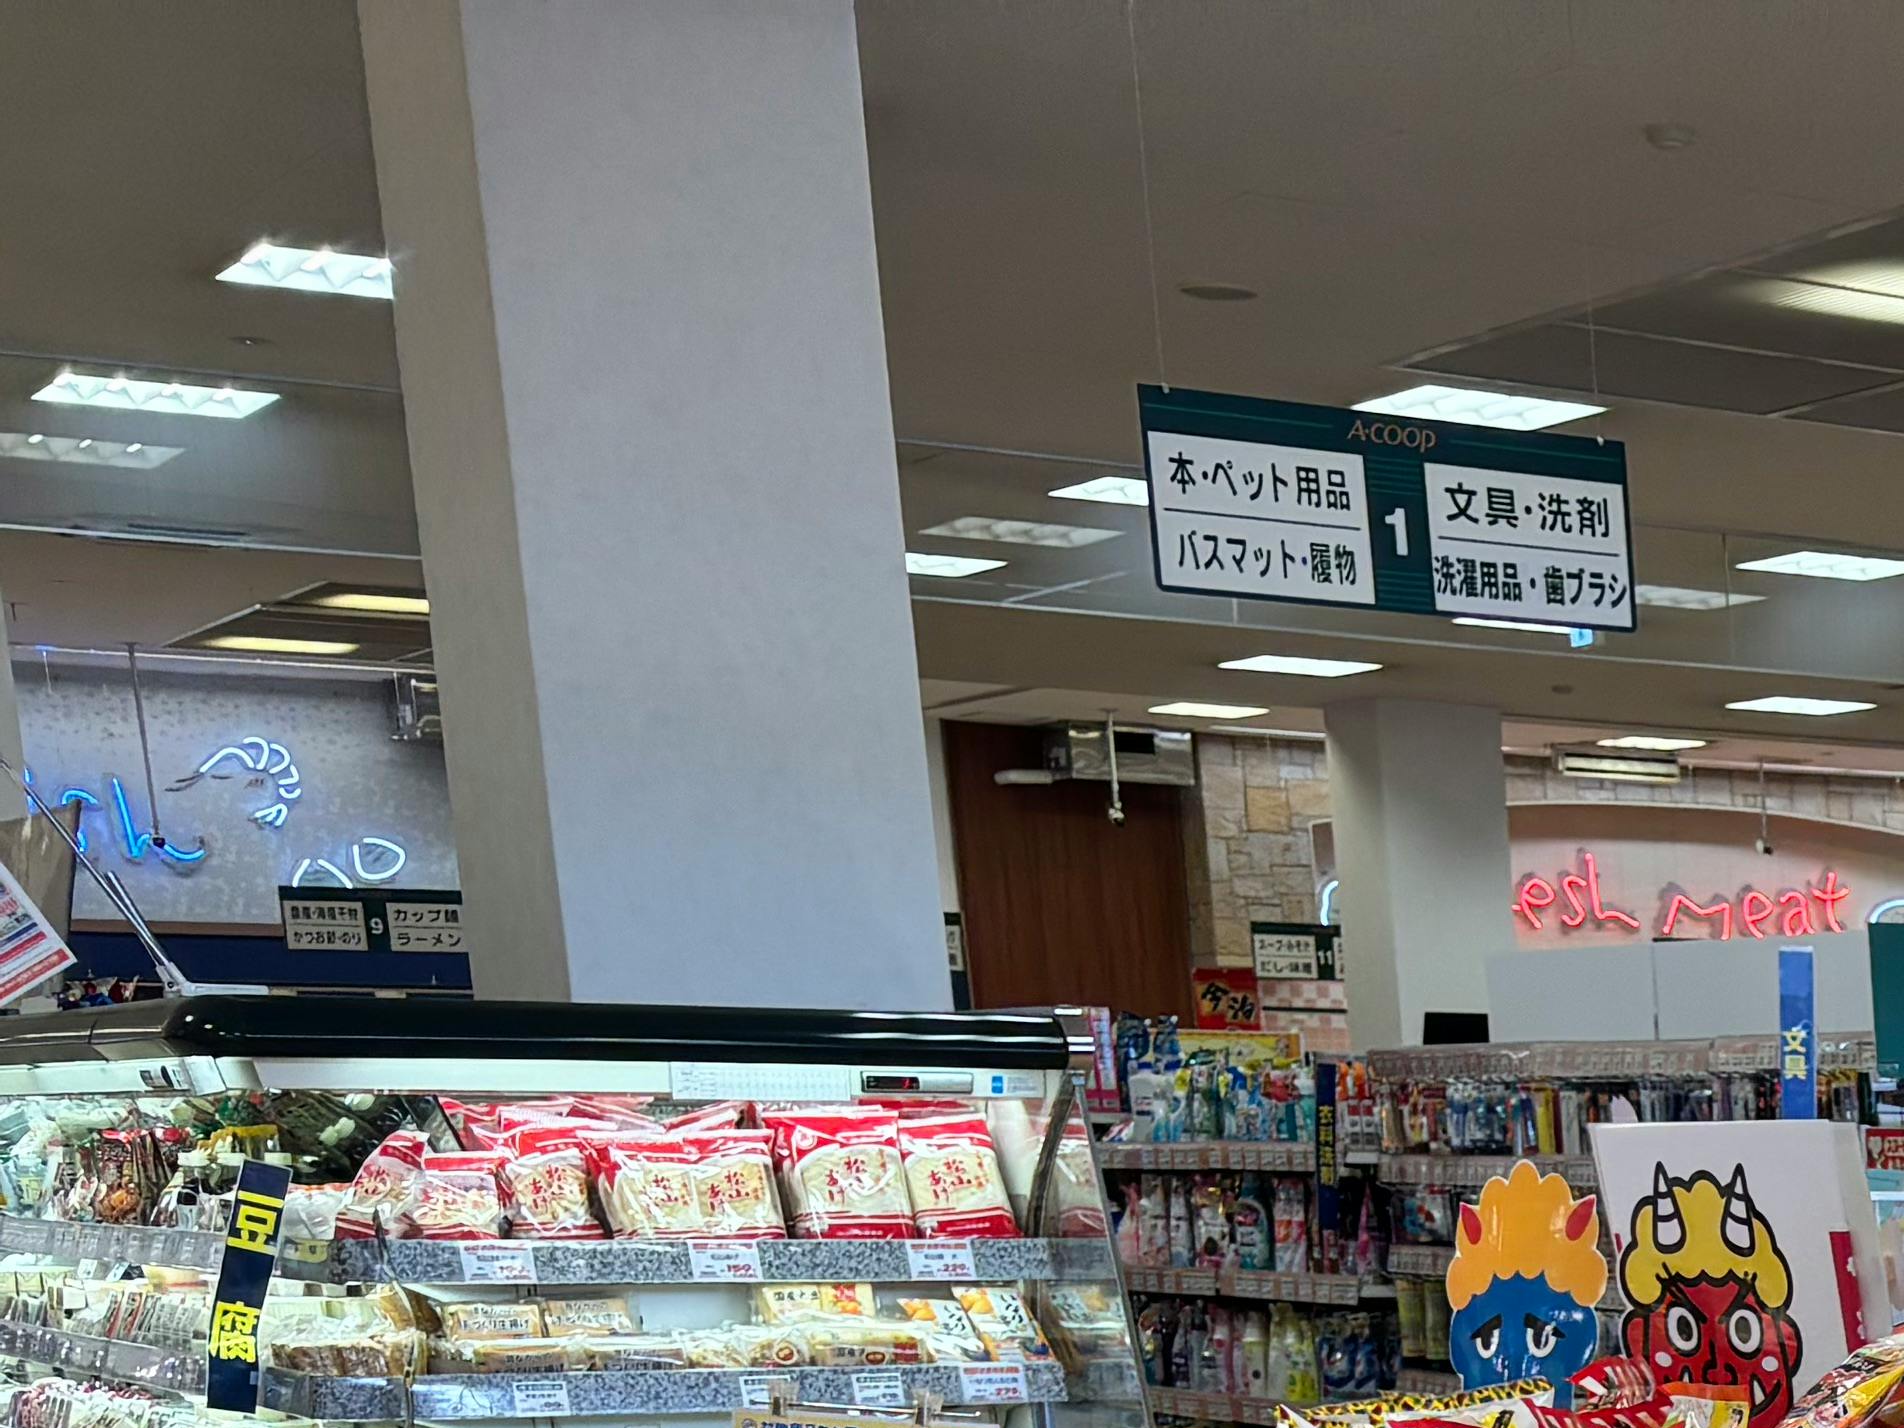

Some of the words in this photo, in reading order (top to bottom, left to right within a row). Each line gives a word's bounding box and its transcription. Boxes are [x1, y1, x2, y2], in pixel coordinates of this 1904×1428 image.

[1167, 451, 1352, 512] 本・ペット用品
[1384, 507, 1409, 556] 1
[1444, 482, 1611, 540] 文具・洗剤
[1177, 529, 1357, 587] バスマット・履物
[1433, 555, 1628, 611] 洗濯用品・歯ブラシ
[369, 917, 384, 936] 9
[1662, 871, 1851, 941] meat
[396, 932, 462, 947] ラーメン
[205, 1184, 288, 1366] 豆腐
